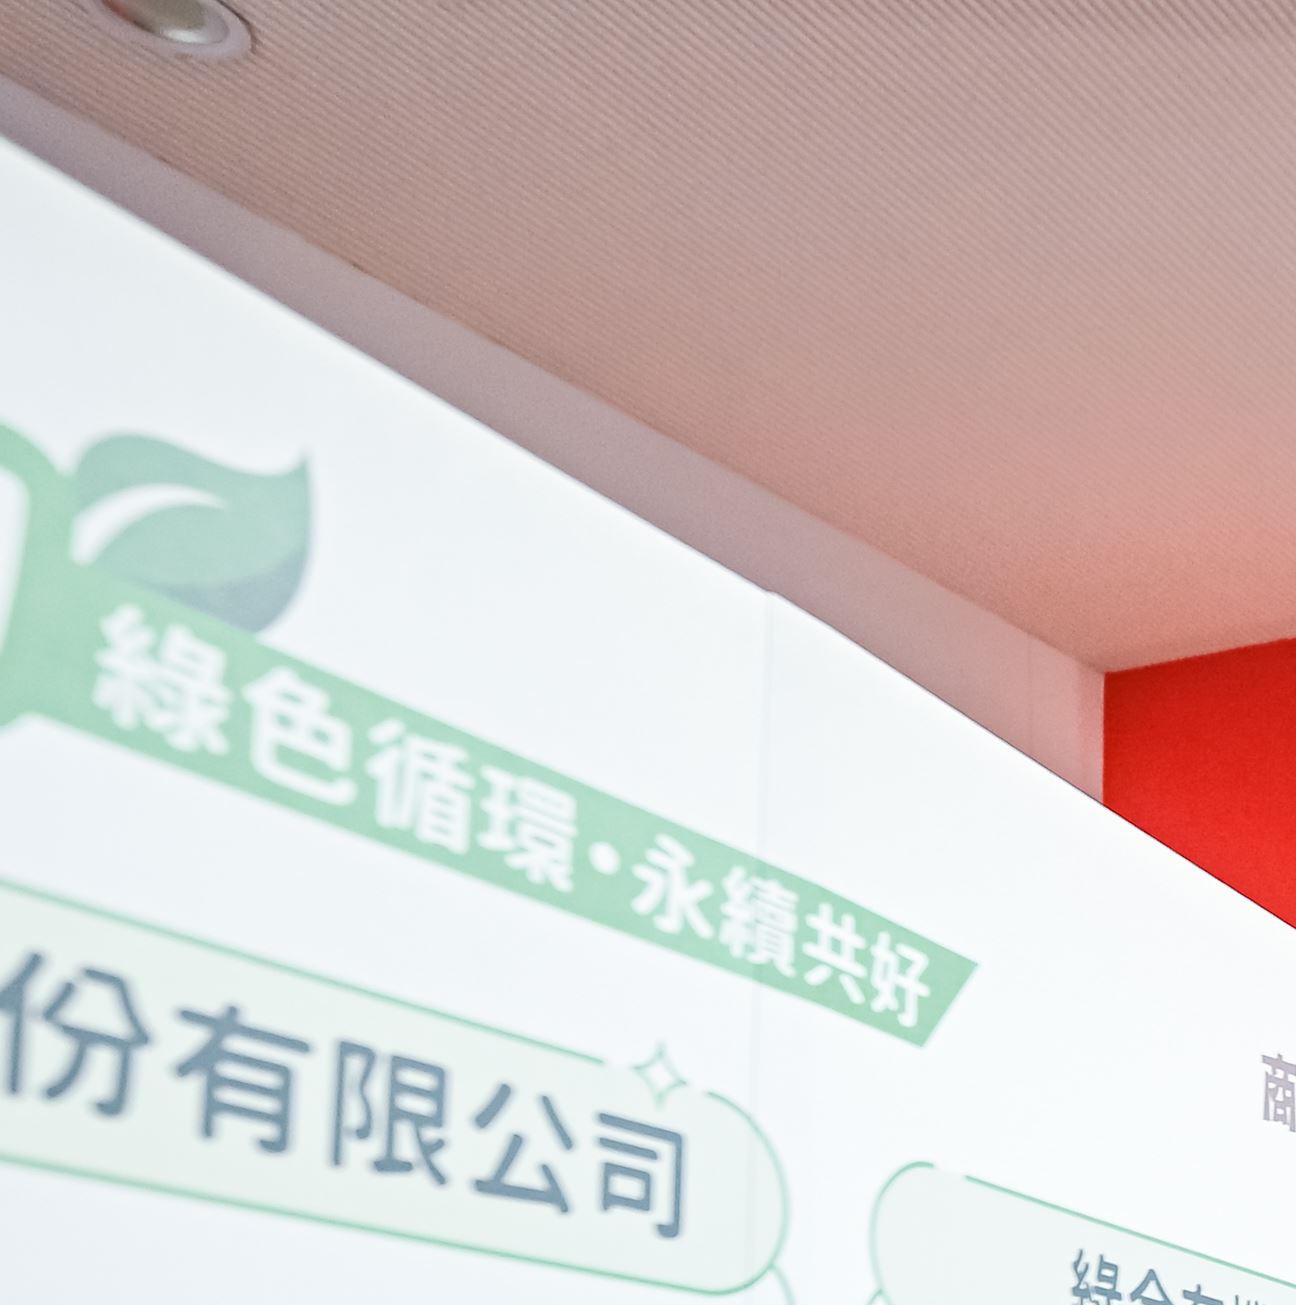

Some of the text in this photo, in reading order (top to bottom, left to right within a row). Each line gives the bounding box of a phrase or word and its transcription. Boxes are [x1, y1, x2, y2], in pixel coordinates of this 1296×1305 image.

[0, 951, 688, 1241] 份有限公司
